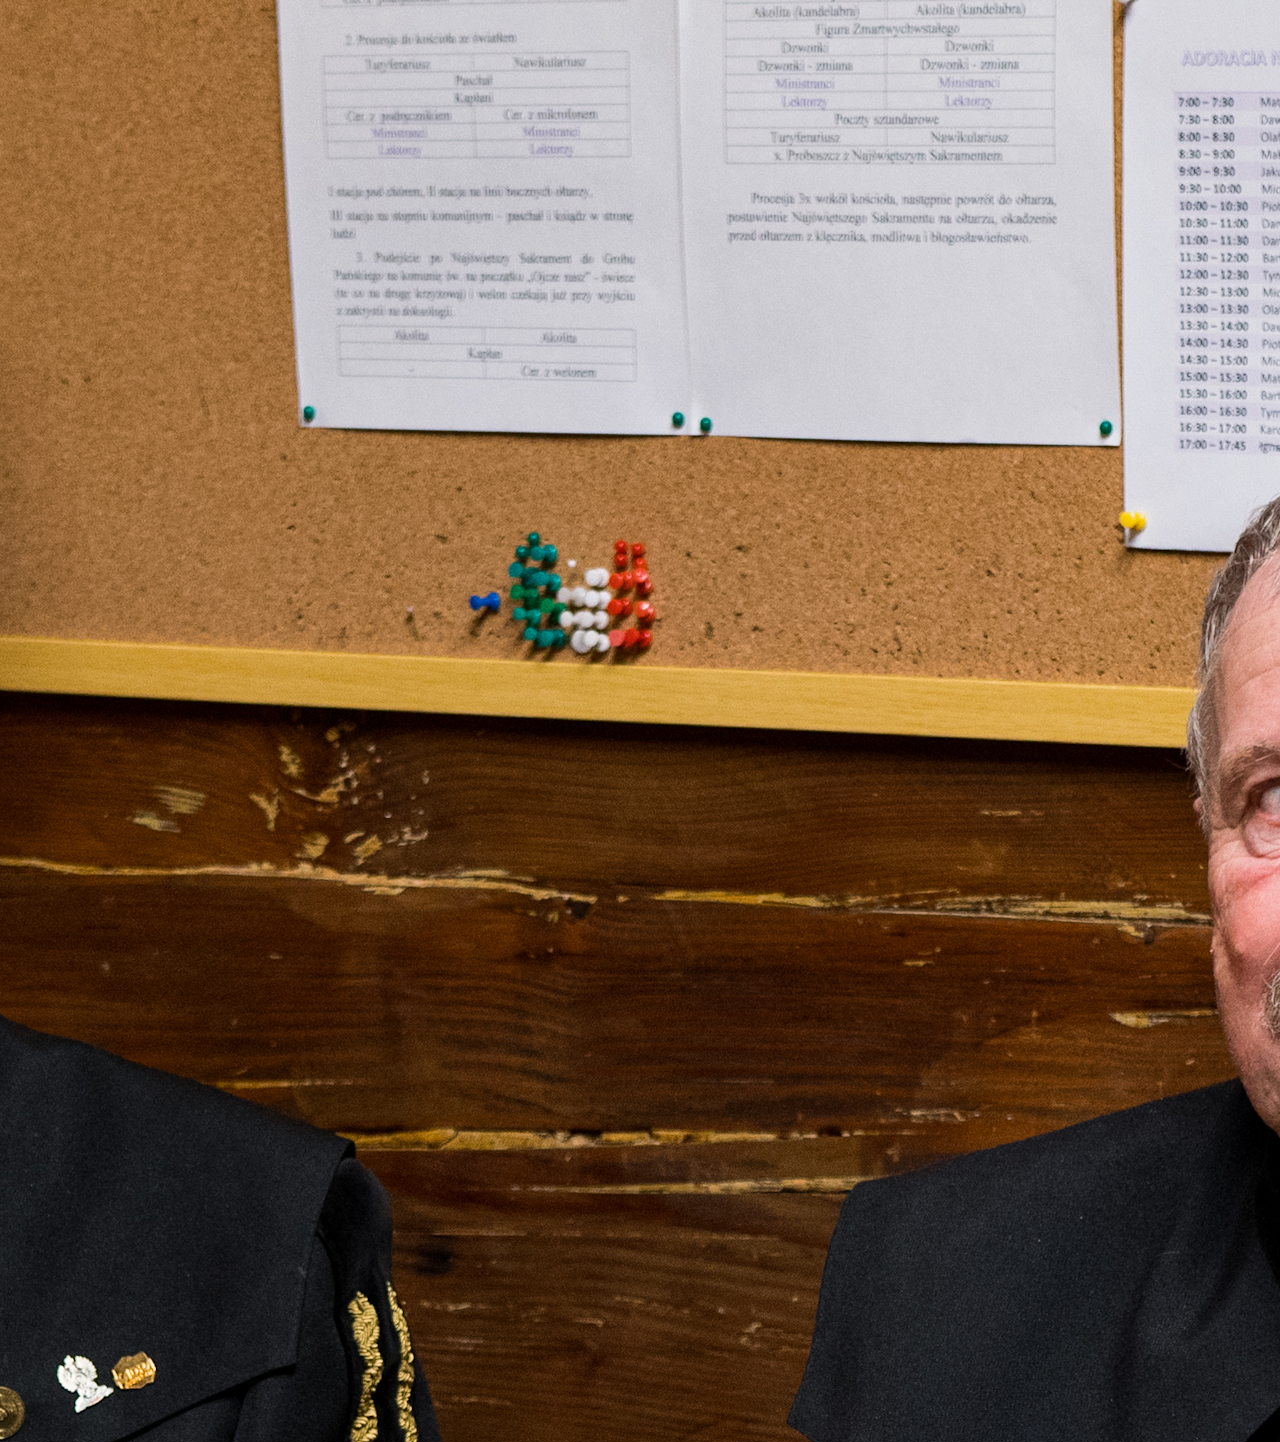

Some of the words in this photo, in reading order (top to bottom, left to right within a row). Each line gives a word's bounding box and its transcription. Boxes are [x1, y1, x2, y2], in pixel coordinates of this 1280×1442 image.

[1181, 50, 1267, 67] ADORACJA
[1178, 97, 1201, 107] 7:00
[1212, 97, 1235, 107] 7:30
[1178, 114, 1201, 125] 7:30
[1212, 114, 1235, 125] 8:00
[1178, 132, 1201, 142] 8:00
[1212, 132, 1235, 142] 8:30
[1180, 269, 1209, 280] 12:00
[1220, 269, 1249, 280] 12:30
